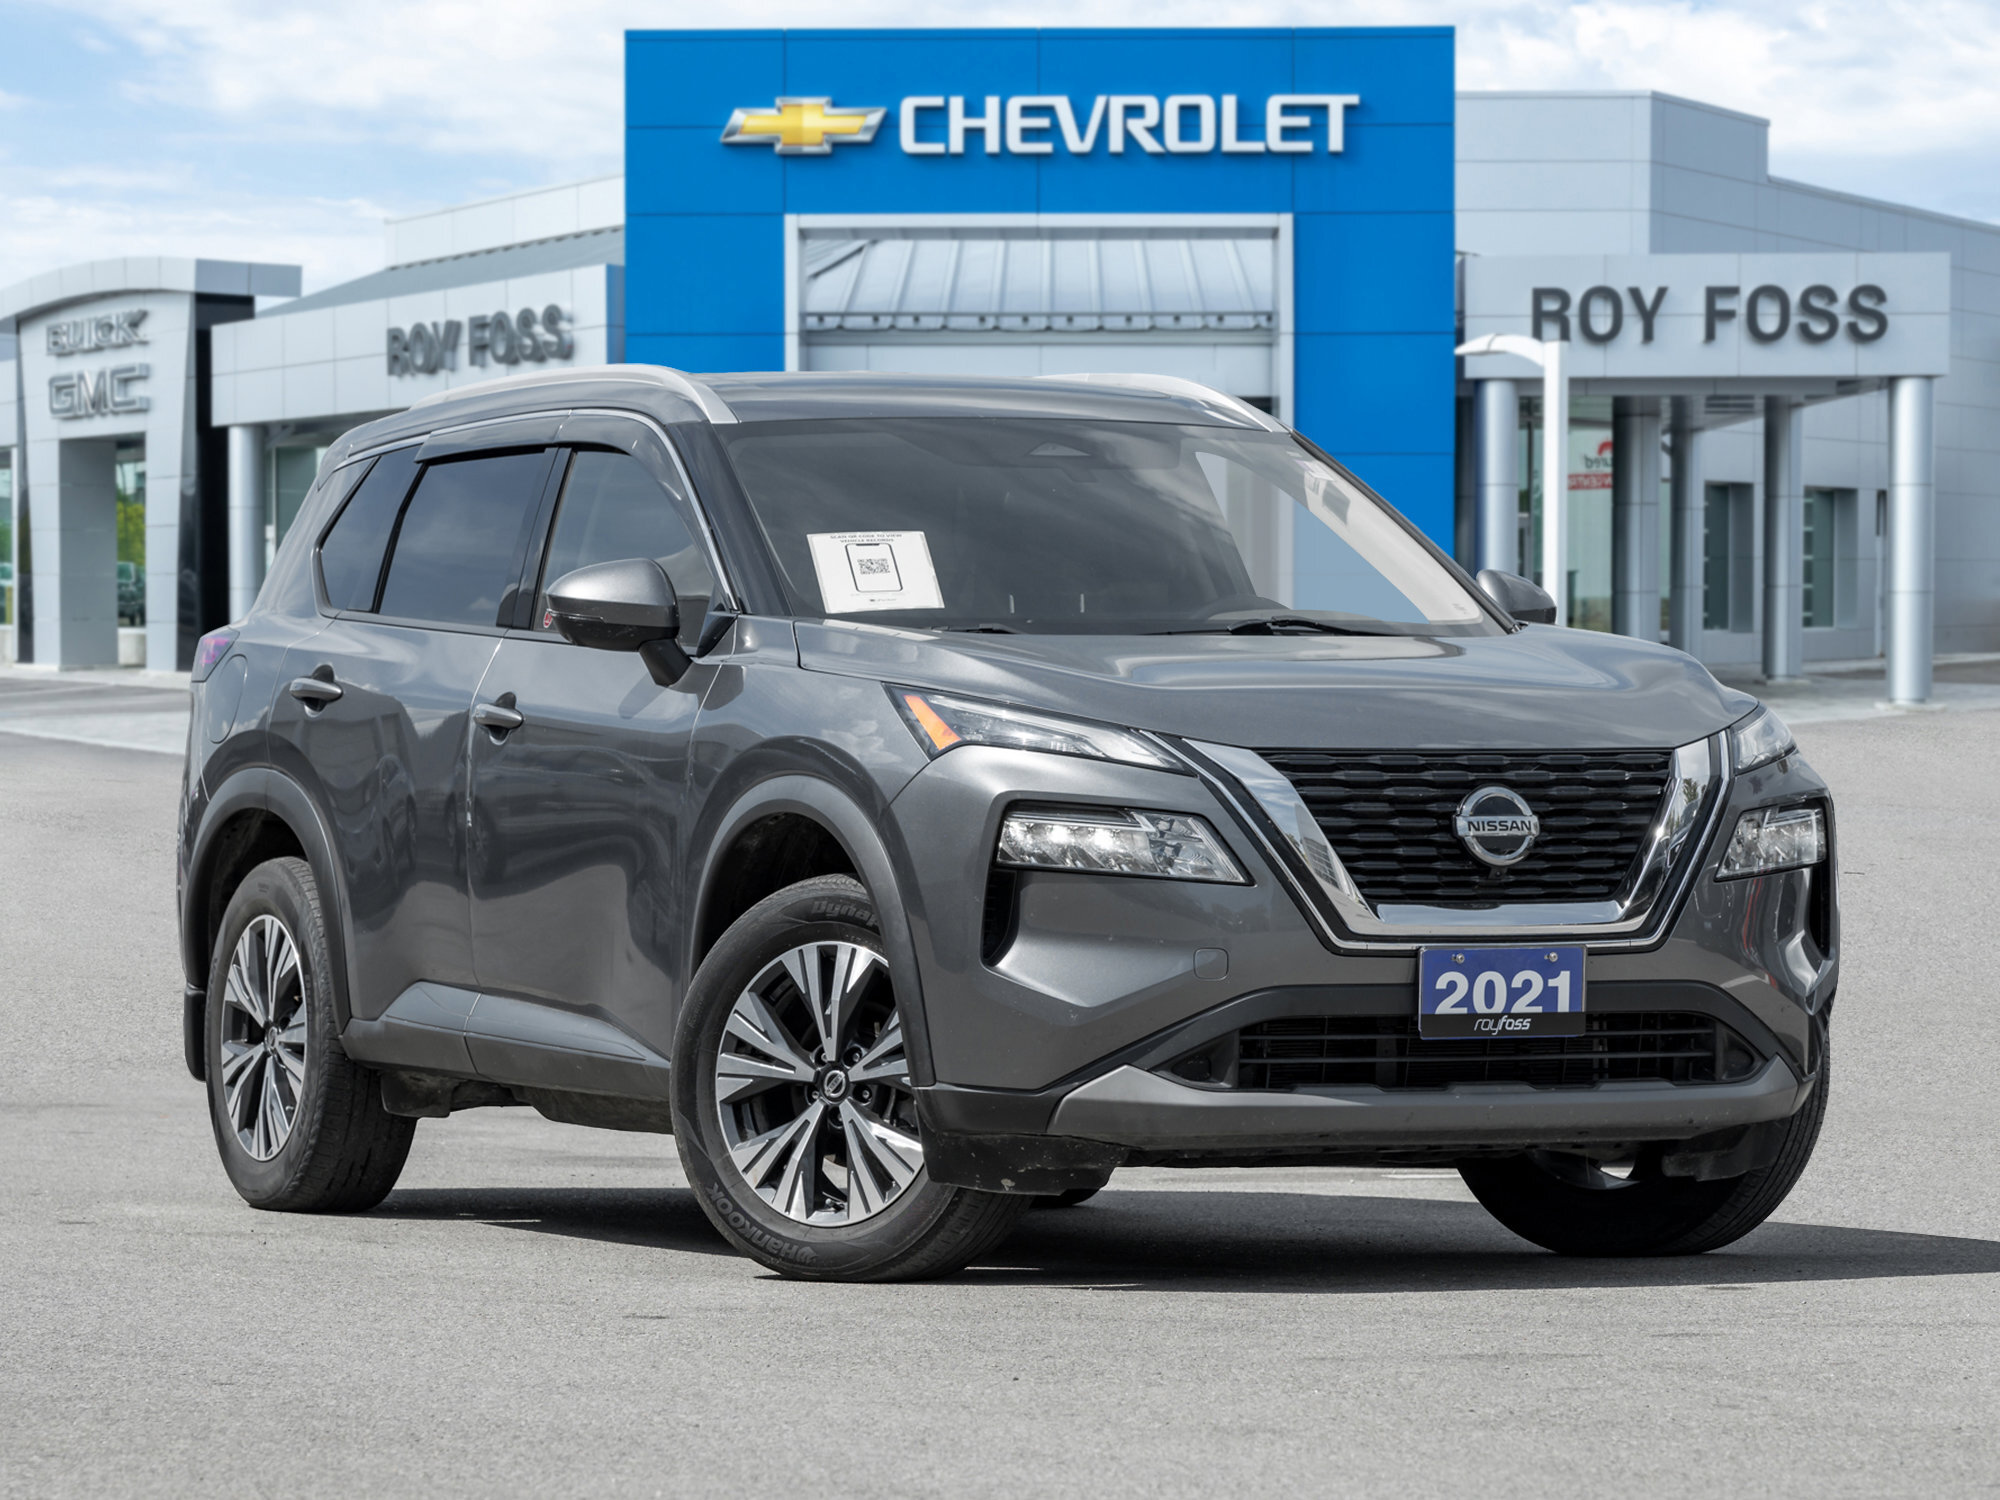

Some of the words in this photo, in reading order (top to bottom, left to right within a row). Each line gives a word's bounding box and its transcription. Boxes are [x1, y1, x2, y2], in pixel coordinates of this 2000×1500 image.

[900, 94, 1360, 155] CHEVROLET
[46, 309, 149, 357] BUICK
[386, 319, 463, 378] ROY
[468, 303, 575, 367] FOSS
[1530, 285, 1669, 344] ROY
[1703, 283, 1889, 345] FOSS
[48, 363, 152, 421] GMC
[1467, 820, 1532, 832] NISSAN
[1434, 969, 1571, 1014] 2021
